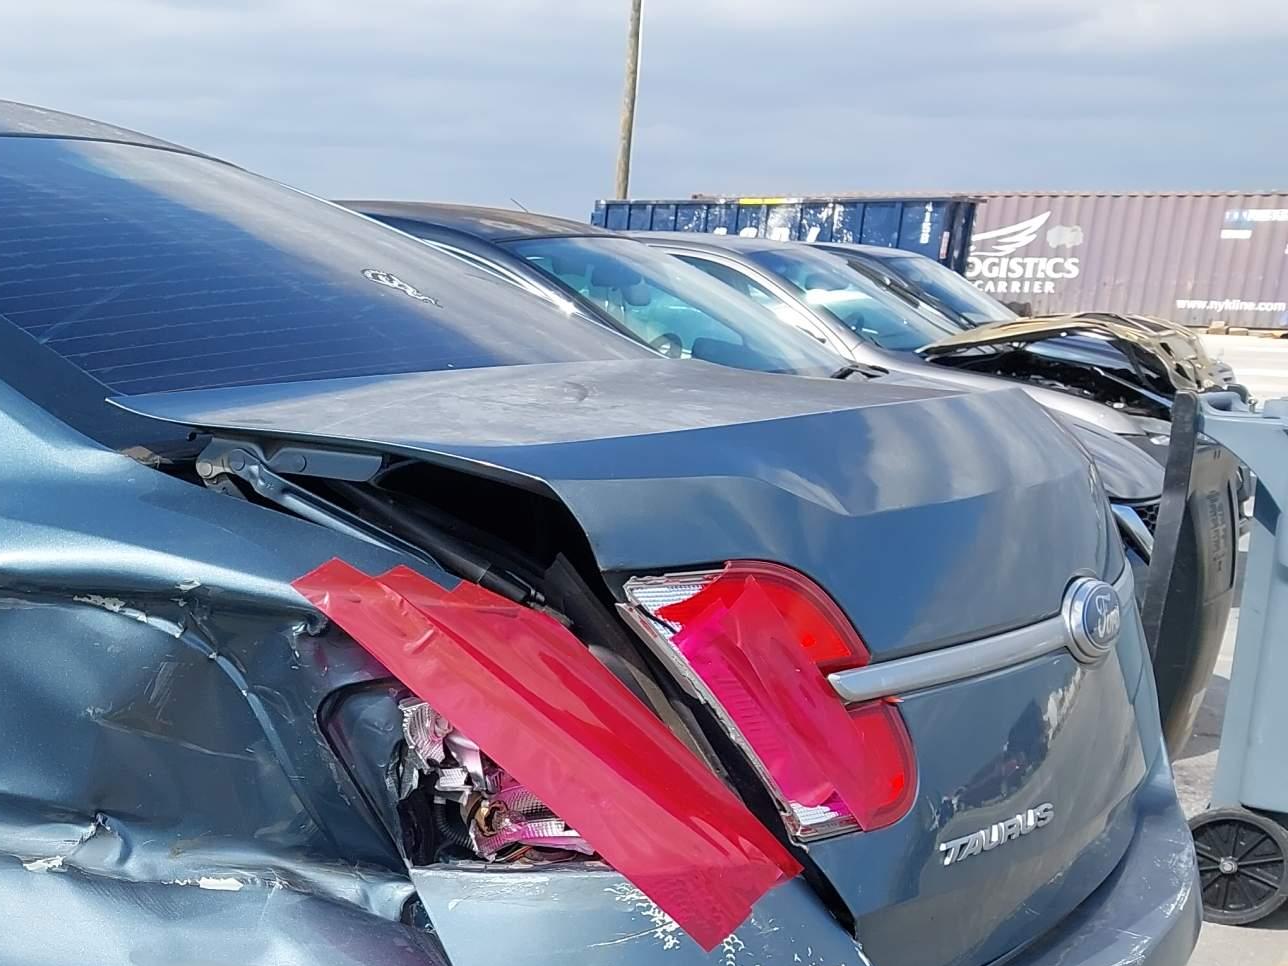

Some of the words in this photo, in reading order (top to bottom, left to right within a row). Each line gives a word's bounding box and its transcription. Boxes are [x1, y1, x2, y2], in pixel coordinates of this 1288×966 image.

[966, 256, 1080, 279] OGISTICS
[1175, 299, 1287, 313] www.nykline.com
[939, 802, 1055, 866] TAURUS
